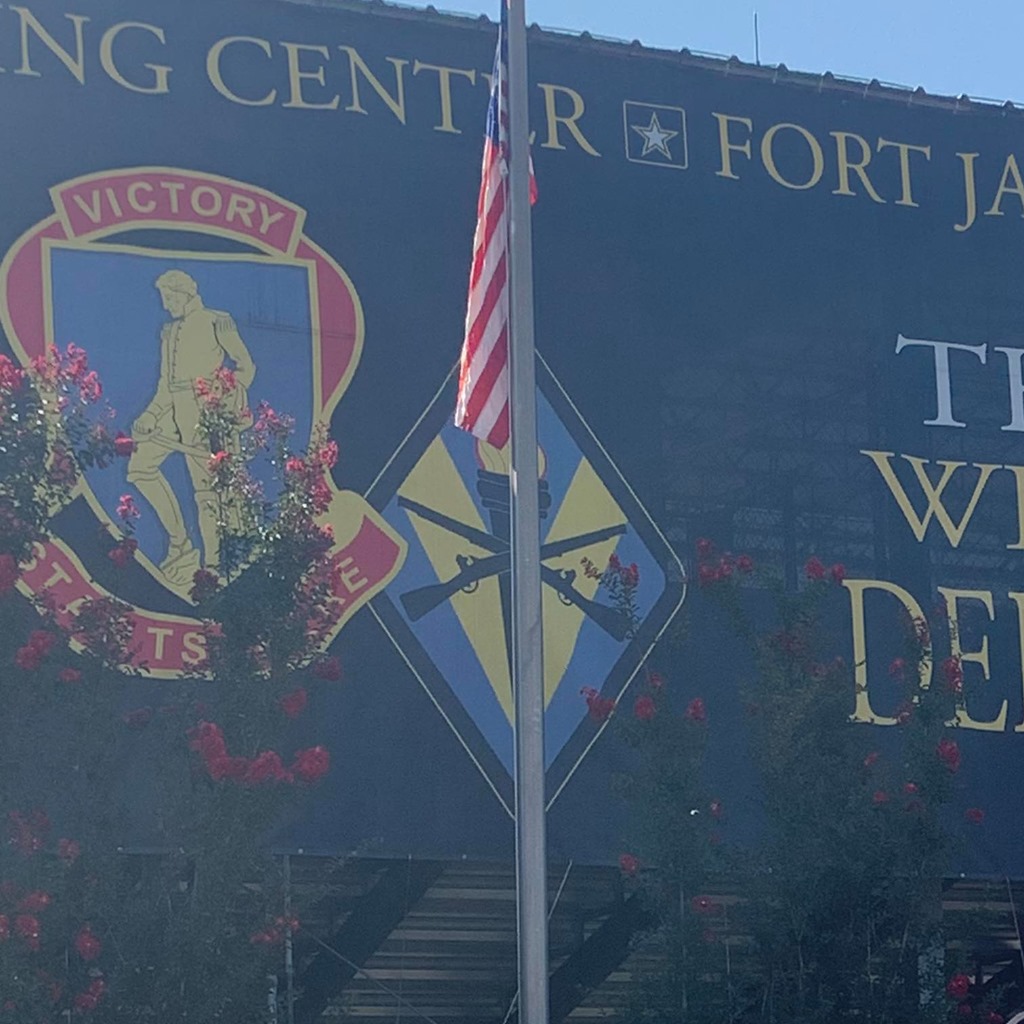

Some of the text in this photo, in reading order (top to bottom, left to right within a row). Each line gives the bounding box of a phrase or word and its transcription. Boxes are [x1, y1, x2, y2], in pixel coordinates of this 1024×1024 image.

[0, 4, 601, 157] NG CENTR
[711, 111, 931, 207] FORT
[73, 180, 287, 237] VICTORY
